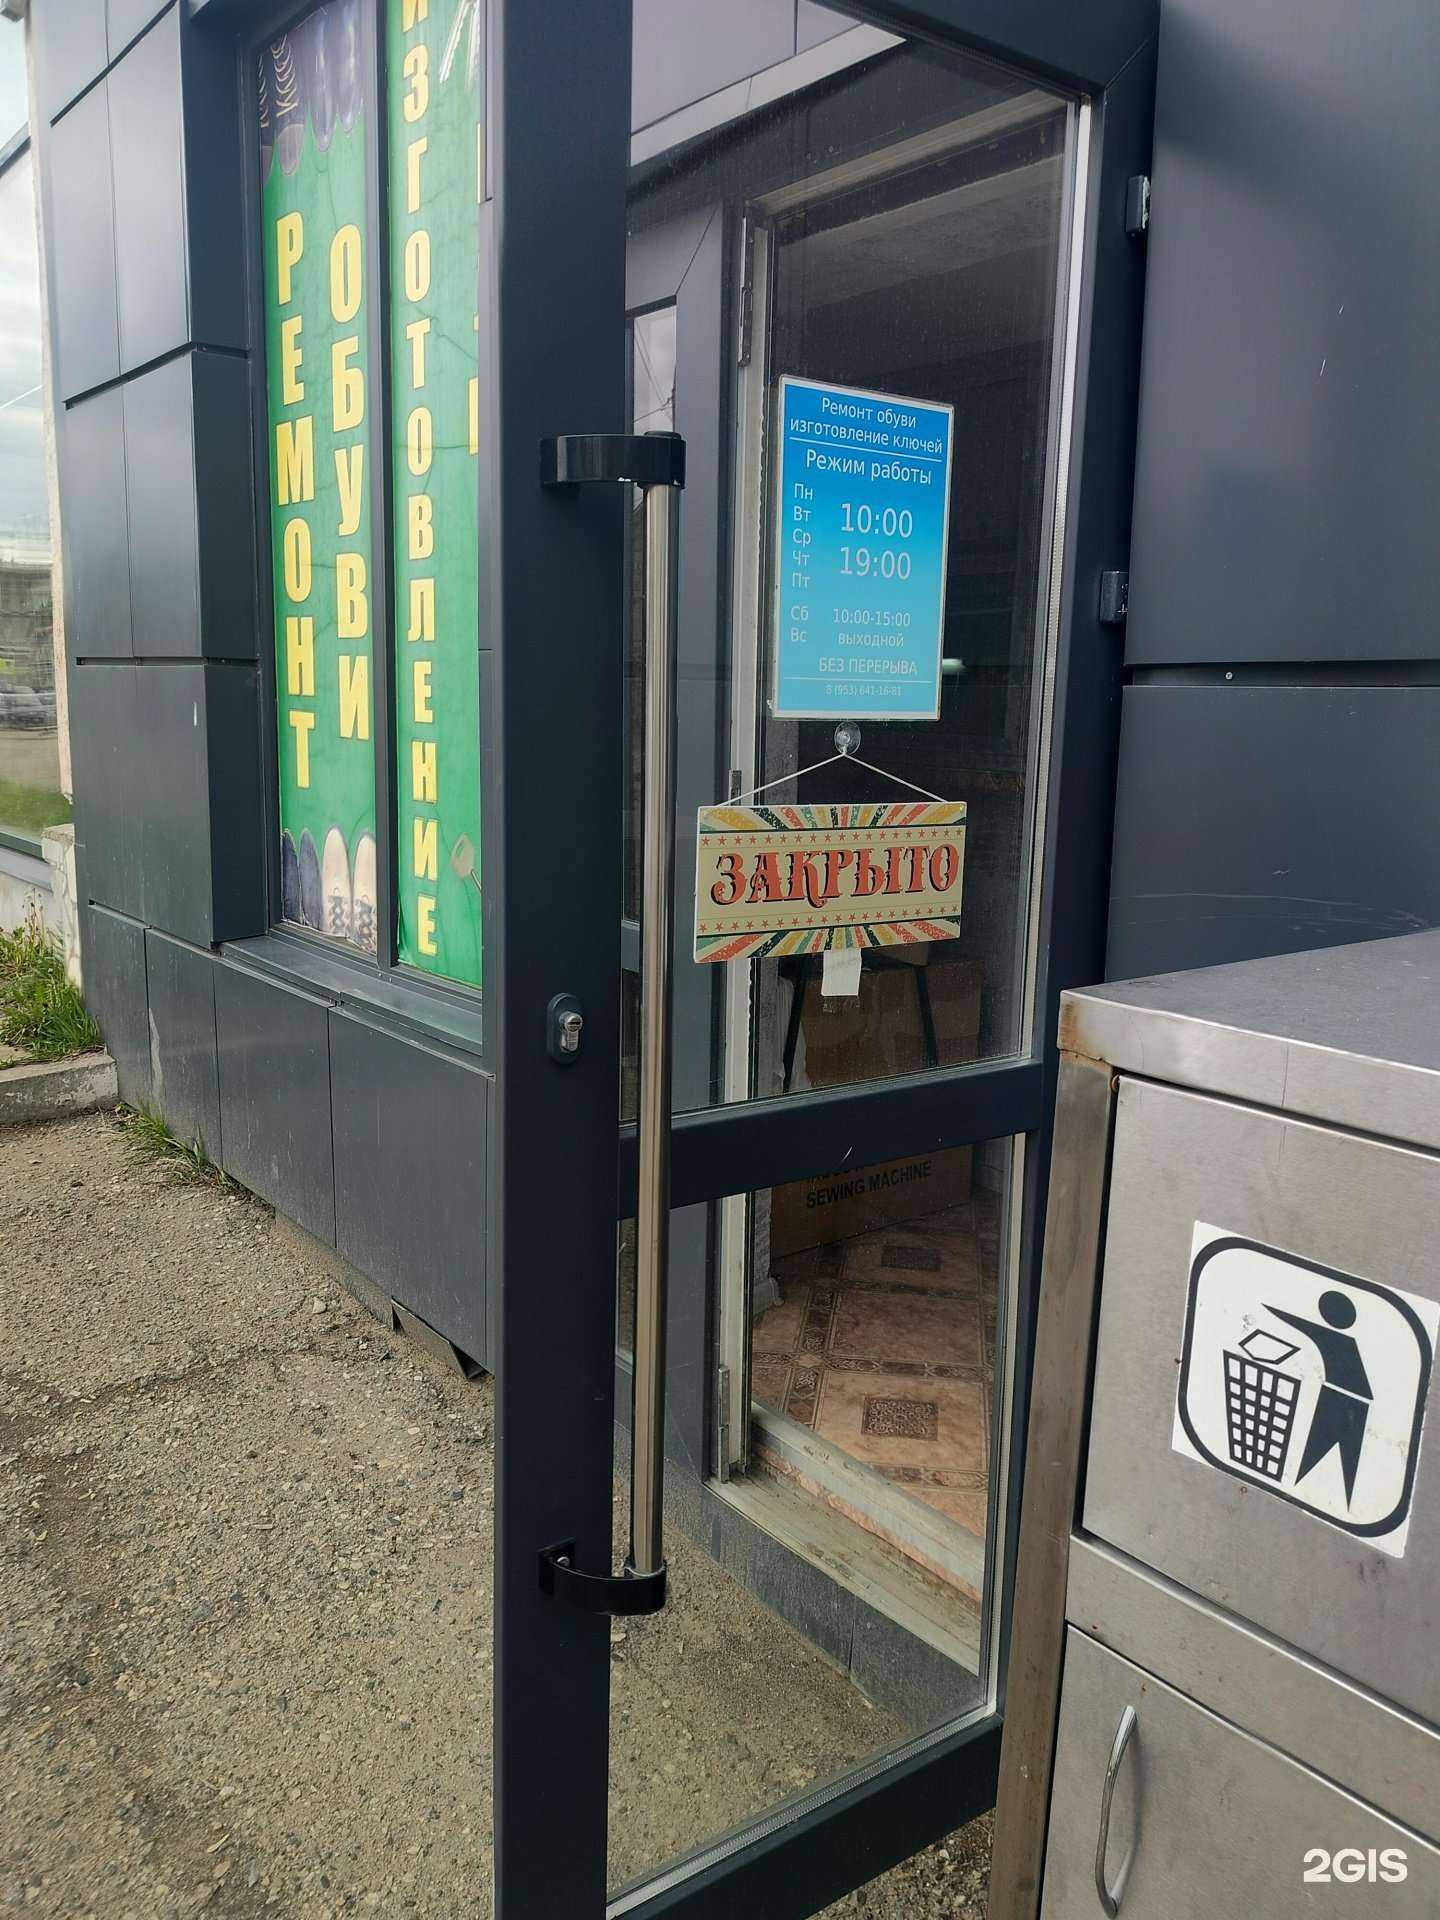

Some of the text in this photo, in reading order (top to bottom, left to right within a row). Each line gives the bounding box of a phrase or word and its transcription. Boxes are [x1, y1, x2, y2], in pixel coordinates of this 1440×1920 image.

[821, 397, 916, 429] Ремонт обуви
[790, 418, 943, 454] изготовление ключей
[329, 224, 371, 740] ОБУВИ
[806, 449, 932, 484] Режим работы
[276, 211, 315, 789] РЕМОНТ
[794, 483, 813, 500] Пн
[793, 505, 811, 522] Вт
[840, 503, 913, 538] 10:00
[792, 528, 811, 547] Ср
[792, 551, 810, 567] Чт
[839, 547, 912, 580] 19:00
[792, 573, 810, 589] Пт
[790, 606, 911, 628] Сб 10:00-15:00
[790, 627, 905, 648] Вс выходной
[819, 657, 918, 676] БЕЗ ПЕРЕРЫВА
[710, 843, 960, 908] ЗАКРЫТО
[806, 1178, 865, 1209] SEWING
[869, 1160, 932, 1192] MACHINE
